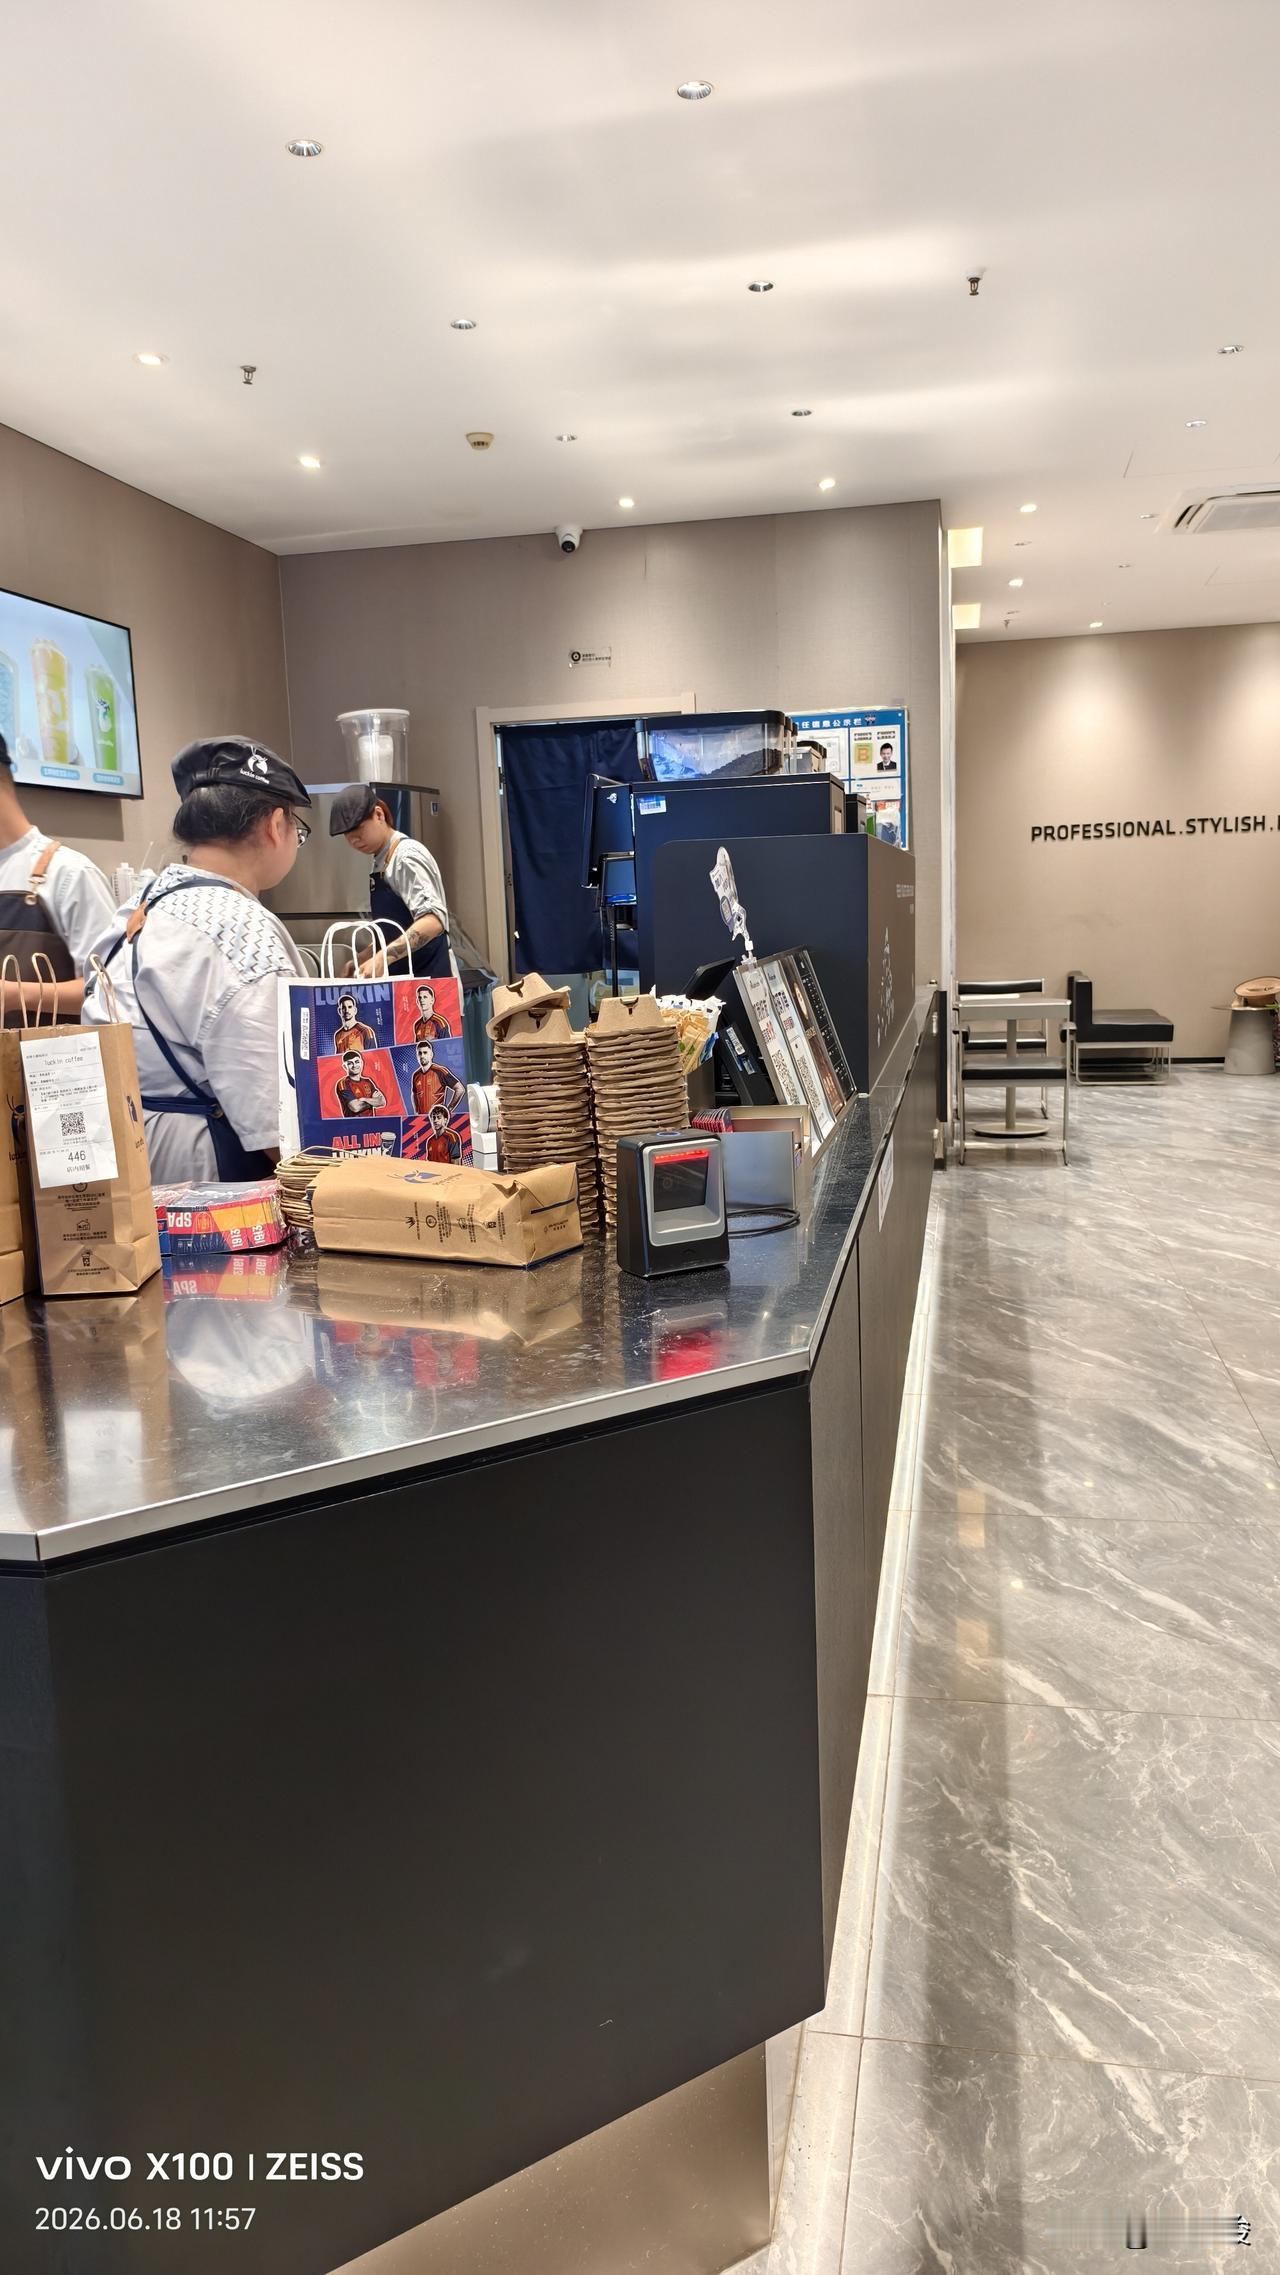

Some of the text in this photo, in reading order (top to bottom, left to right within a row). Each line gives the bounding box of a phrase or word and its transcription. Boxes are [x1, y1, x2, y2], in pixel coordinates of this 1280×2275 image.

[858, 748, 869, 761] B
[64, 1055, 83, 1064] coffee
[333, 1132, 381, 1150] ALL IN
[68, 1150, 86, 1162] 446
[167, 1211, 192, 1228] SPA
[230, 1228, 243, 1248] 1913
[252, 1224, 266, 1245] 1913
